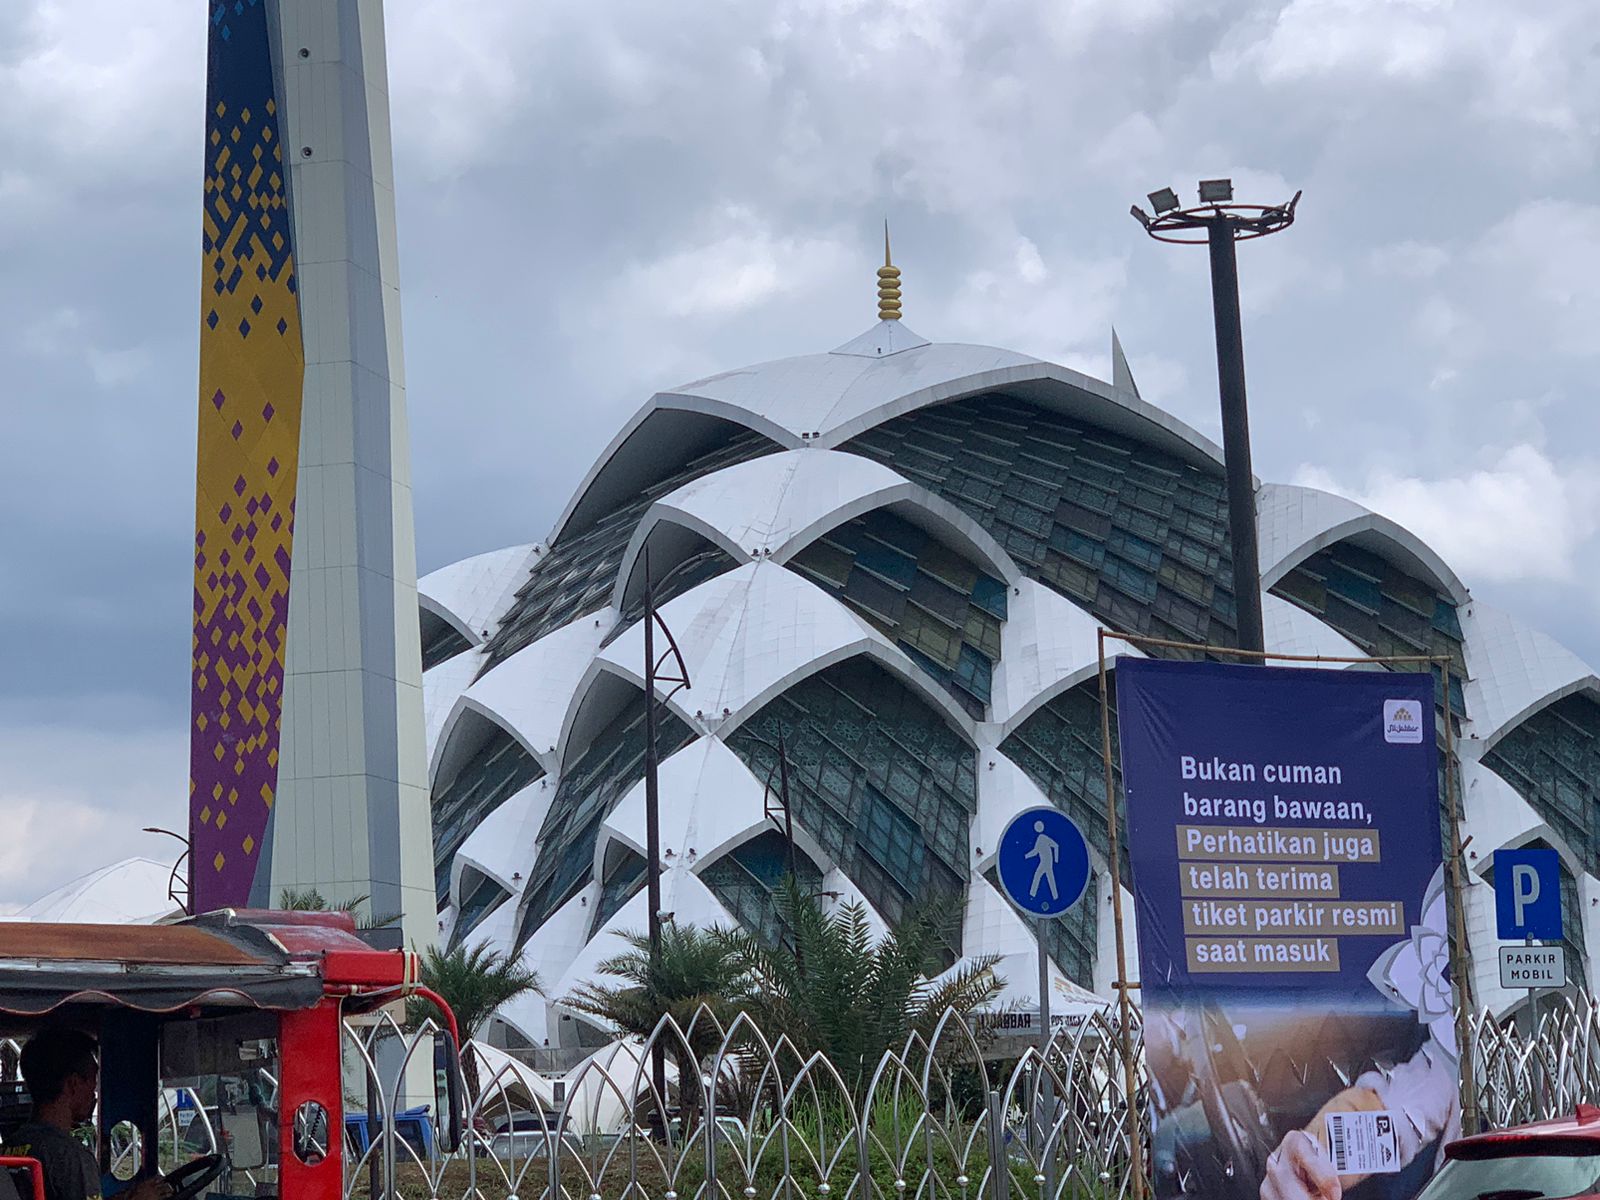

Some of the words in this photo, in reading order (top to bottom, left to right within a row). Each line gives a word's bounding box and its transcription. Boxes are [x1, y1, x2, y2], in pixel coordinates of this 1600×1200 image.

[1181, 756, 1255, 781] Bukan
[1263, 764, 1341, 784] cuman
[1183, 792, 1266, 823] barang
[1274, 795, 1372, 824] bawaan,
[1186, 829, 1316, 855] Perhatikan
[1323, 831, 1373, 861] juga
[1189, 865, 1249, 890] telah
[1255, 867, 1333, 890] terima
[1512, 864, 1540, 927] P
[1192, 901, 1248, 926] tiket
[1254, 902, 1325, 931] parkir
[1332, 902, 1397, 926] resmi
[1196, 940, 1247, 963] saat
[1254, 938, 1330, 962] masuk
[1506, 954, 1556, 965] PARKIR
[1511, 969, 1553, 980] MOBIL
